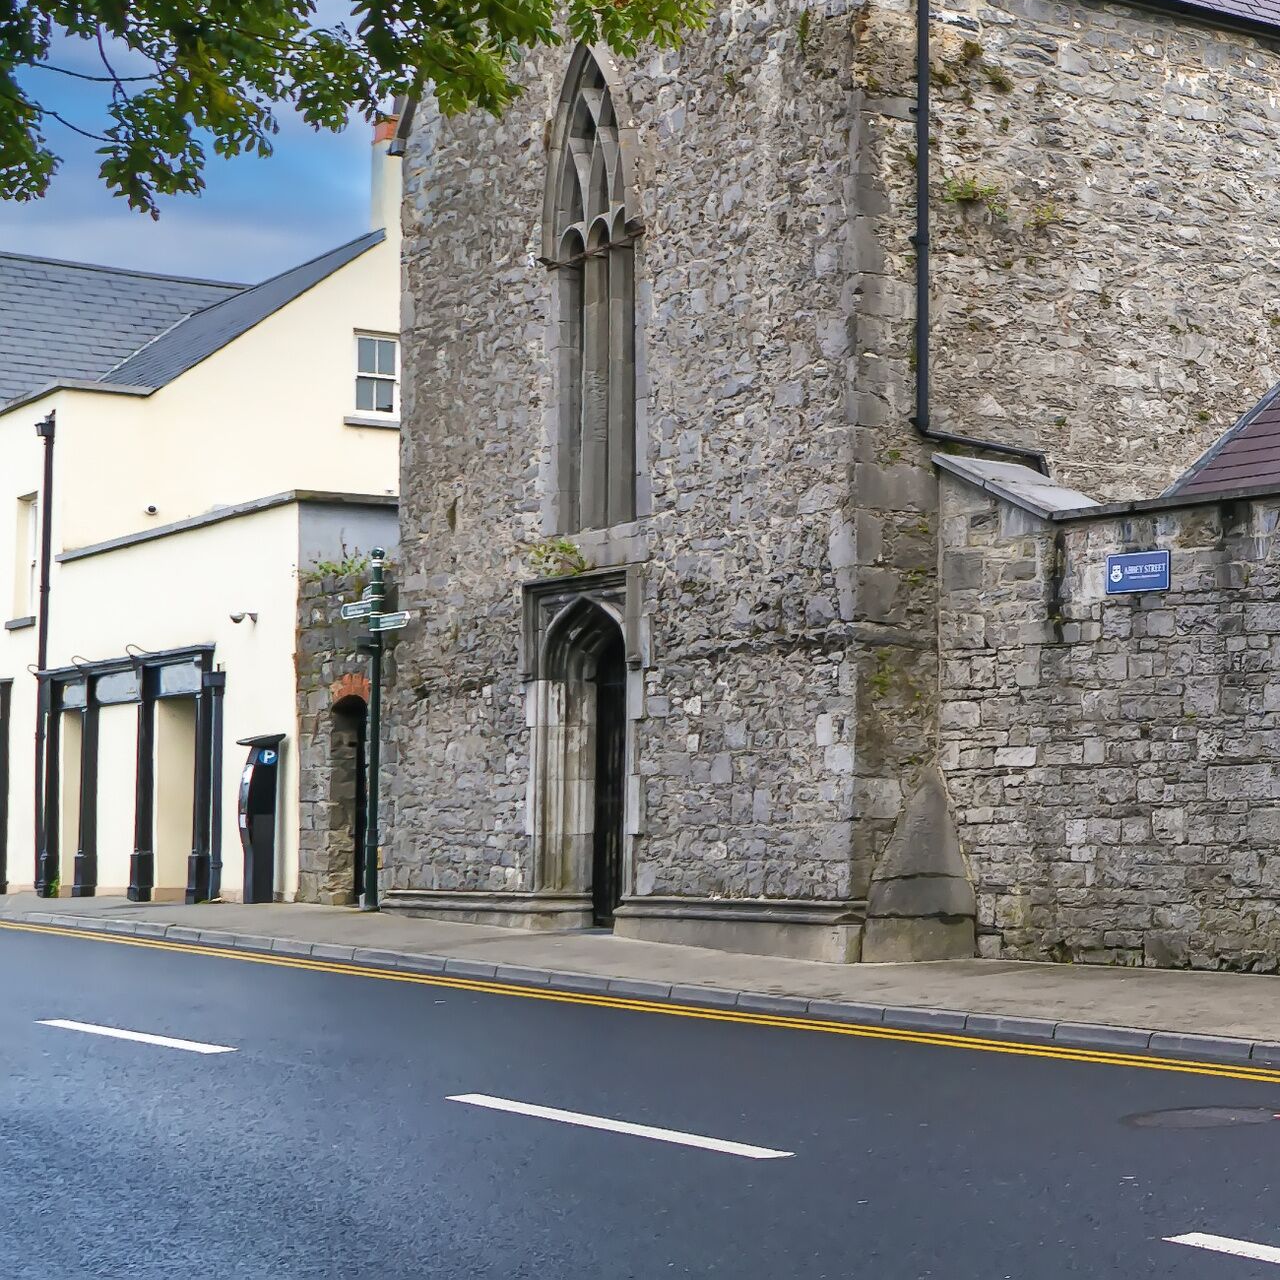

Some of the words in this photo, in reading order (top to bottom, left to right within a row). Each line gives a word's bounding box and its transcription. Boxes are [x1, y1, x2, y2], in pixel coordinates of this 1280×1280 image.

[1124, 565, 1143, 574] ABBEY
[1144, 563, 1166, 573] STREET
[264, 750, 275, 763] P
